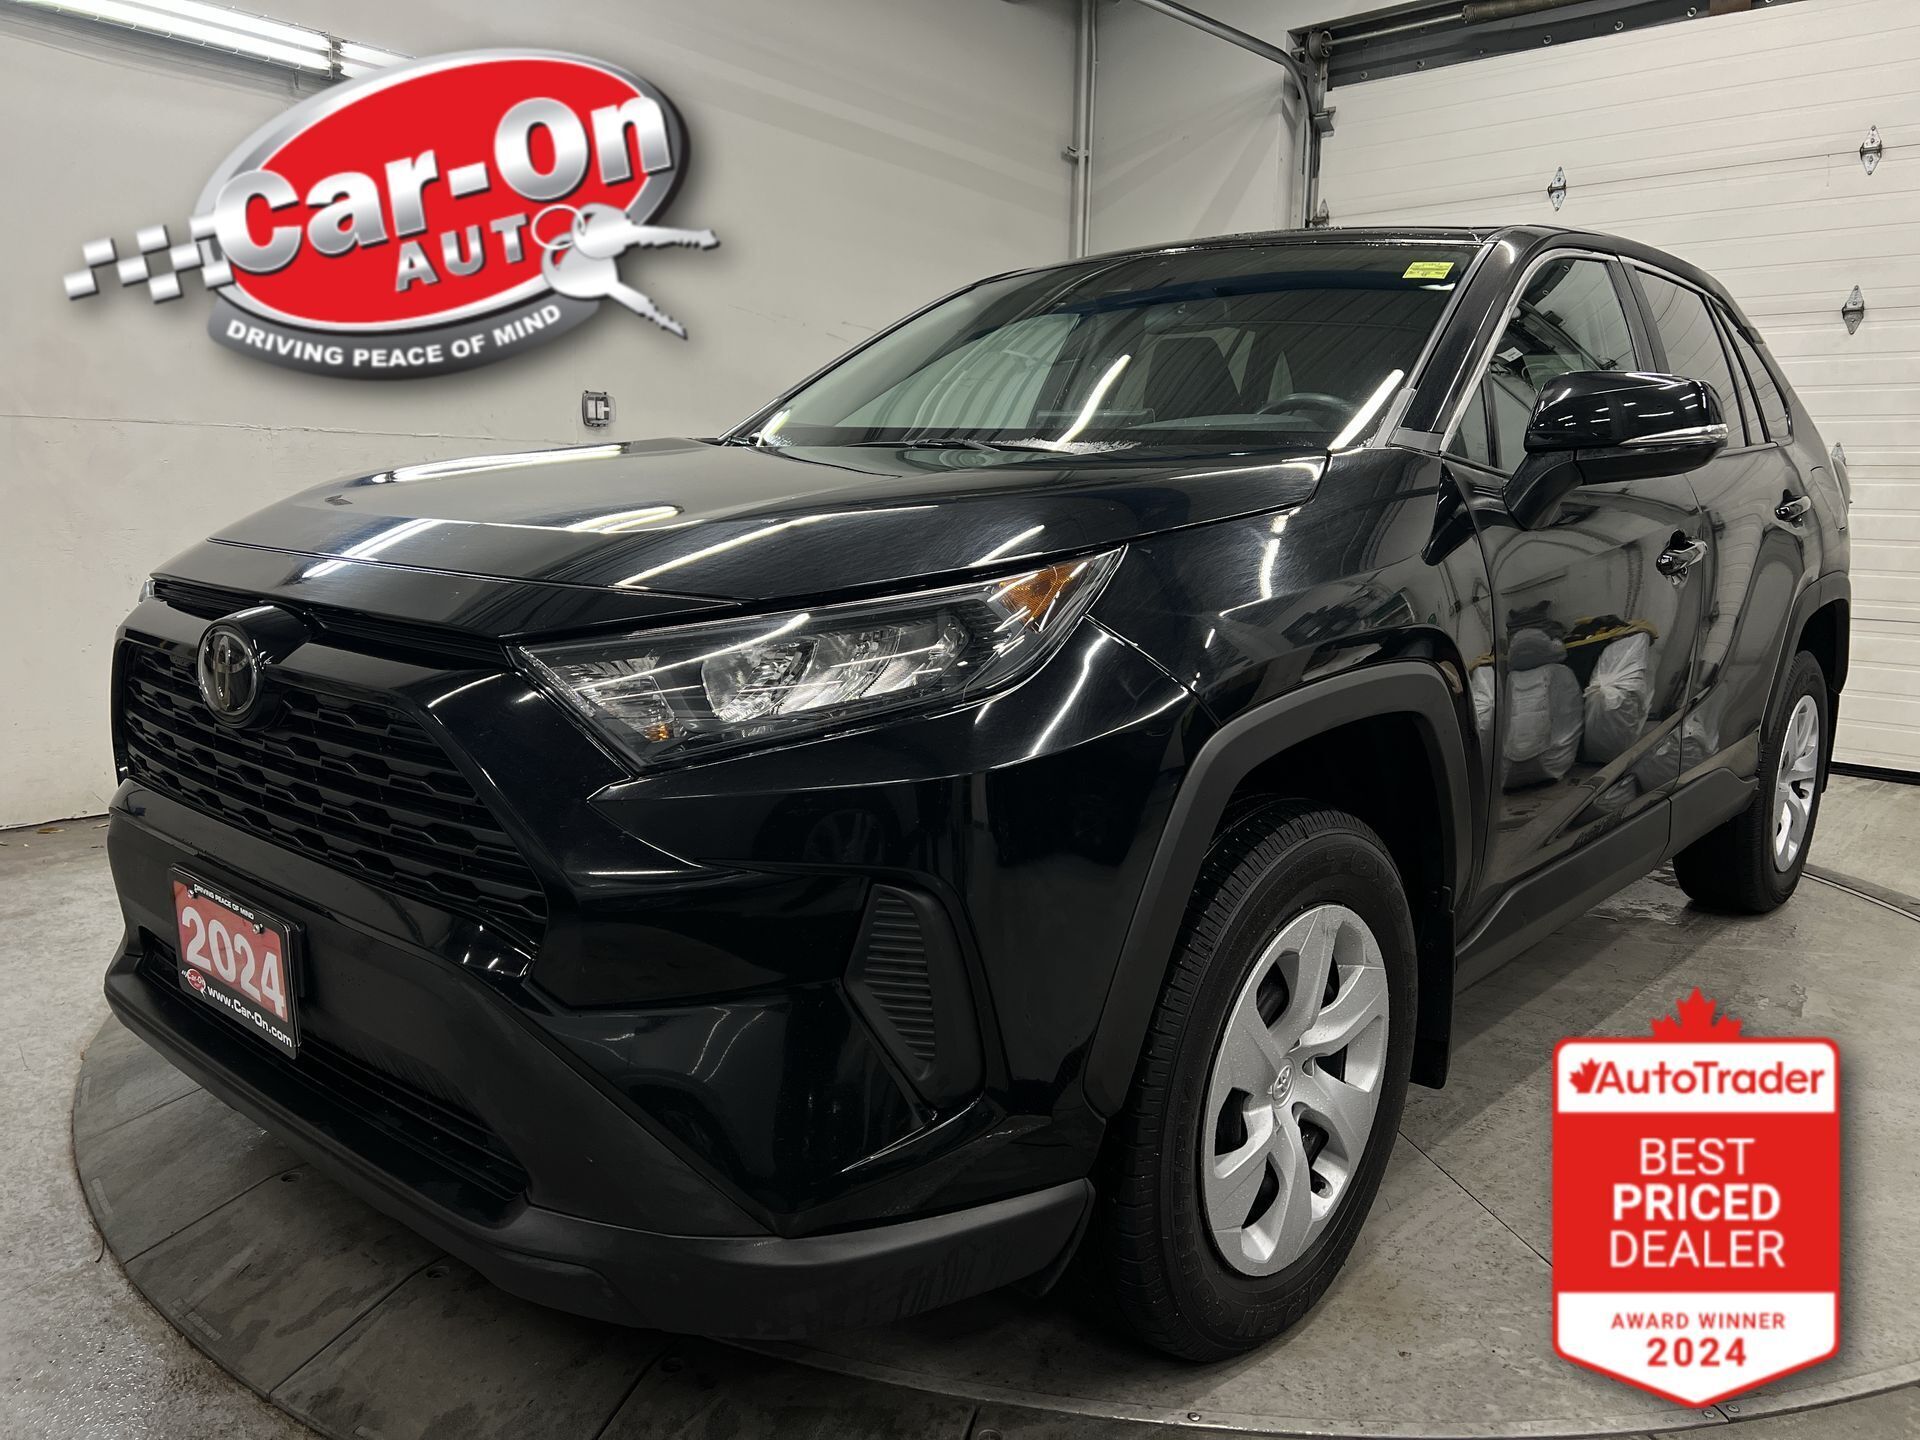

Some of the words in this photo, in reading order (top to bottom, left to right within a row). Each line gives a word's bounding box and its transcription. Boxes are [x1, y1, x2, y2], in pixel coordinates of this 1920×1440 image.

[193, 883, 215, 899] DRIVING
[214, 894, 232, 909] PEACE
[231, 903, 240, 912] OF
[239, 907, 255, 920] MIND
[182, 906, 286, 1018] 2024
[207, 985, 293, 1048] www.Car-On.com
